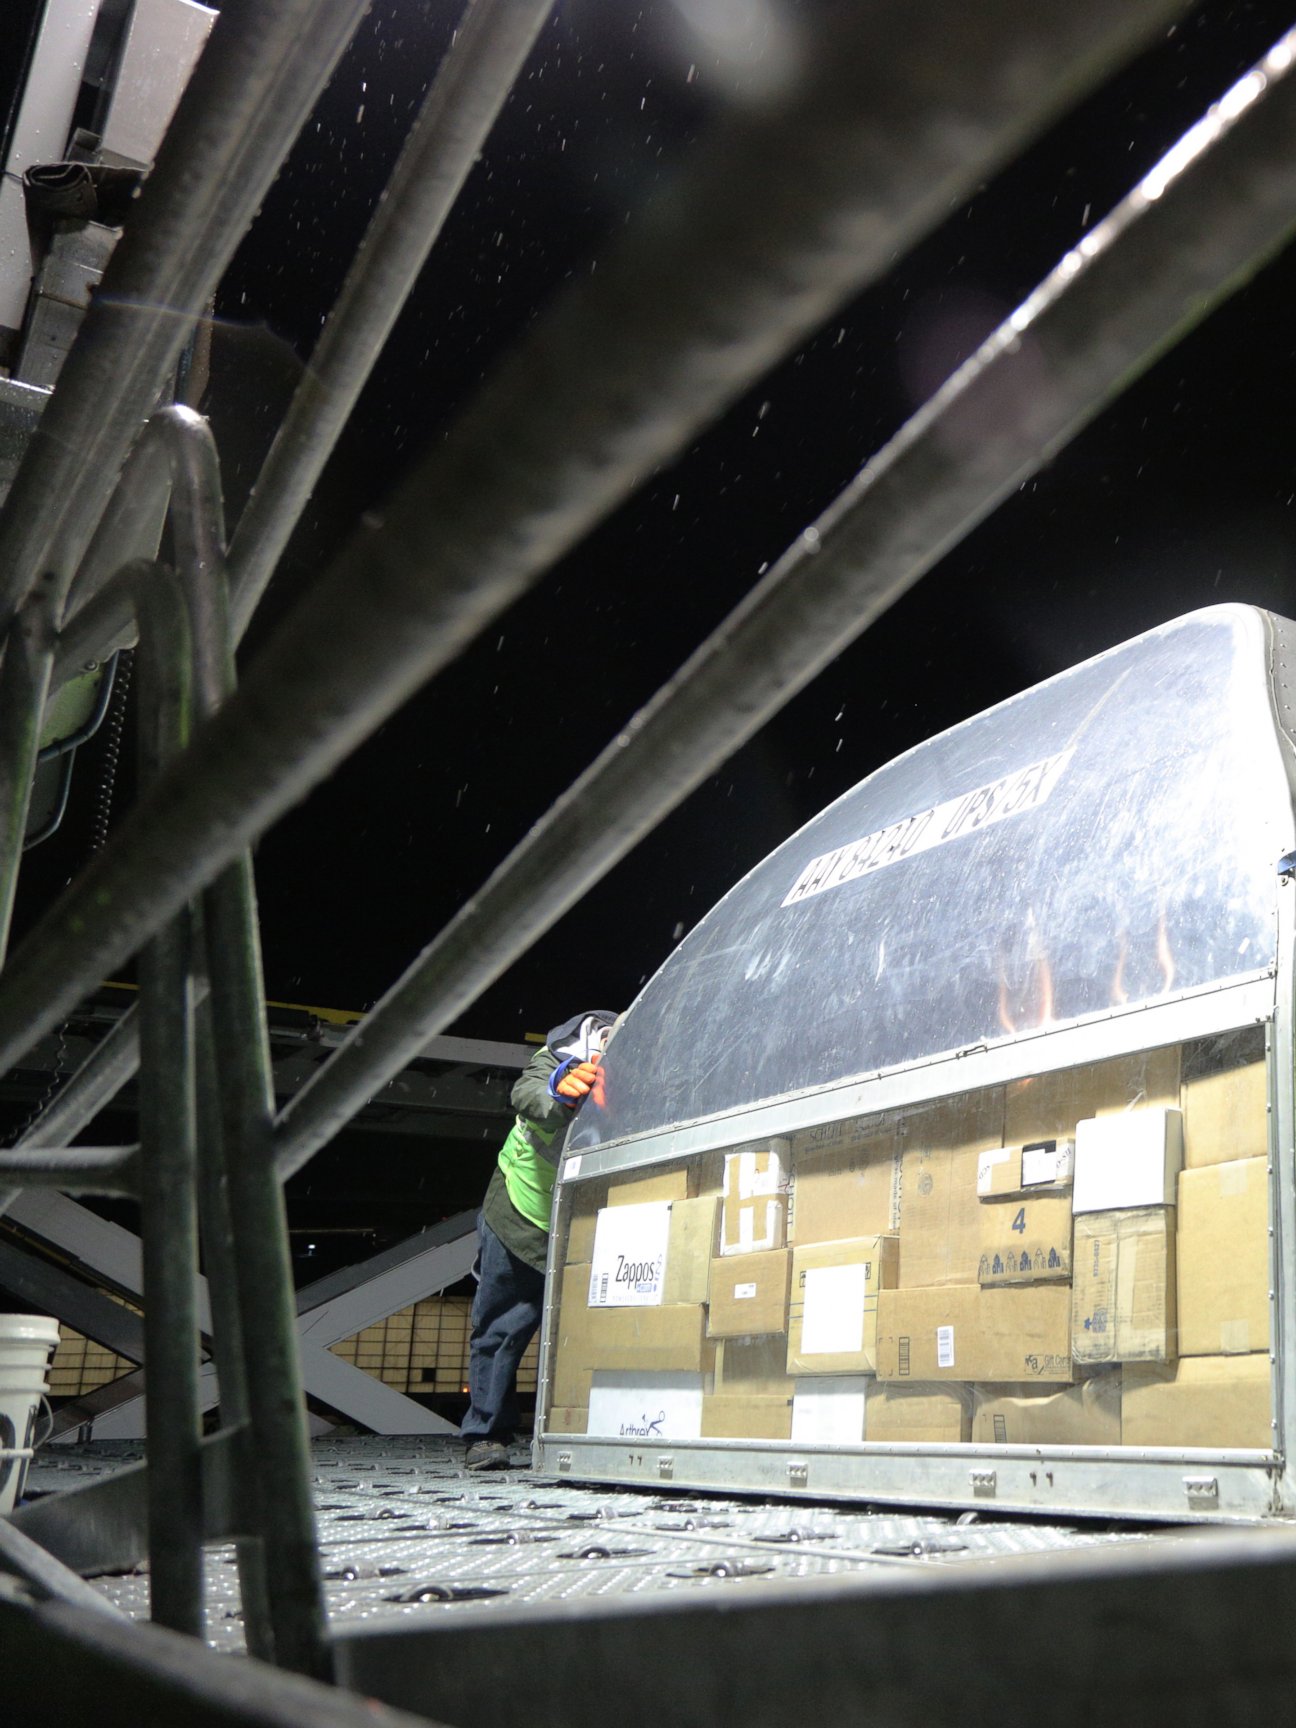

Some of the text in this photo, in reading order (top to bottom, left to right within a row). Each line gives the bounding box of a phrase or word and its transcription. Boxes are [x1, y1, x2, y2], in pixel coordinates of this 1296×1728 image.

[941, 755, 1062, 840] UPS/5X
[1012, 1208, 1026, 1234] 4
[615, 1254, 655, 1290] Zappos
